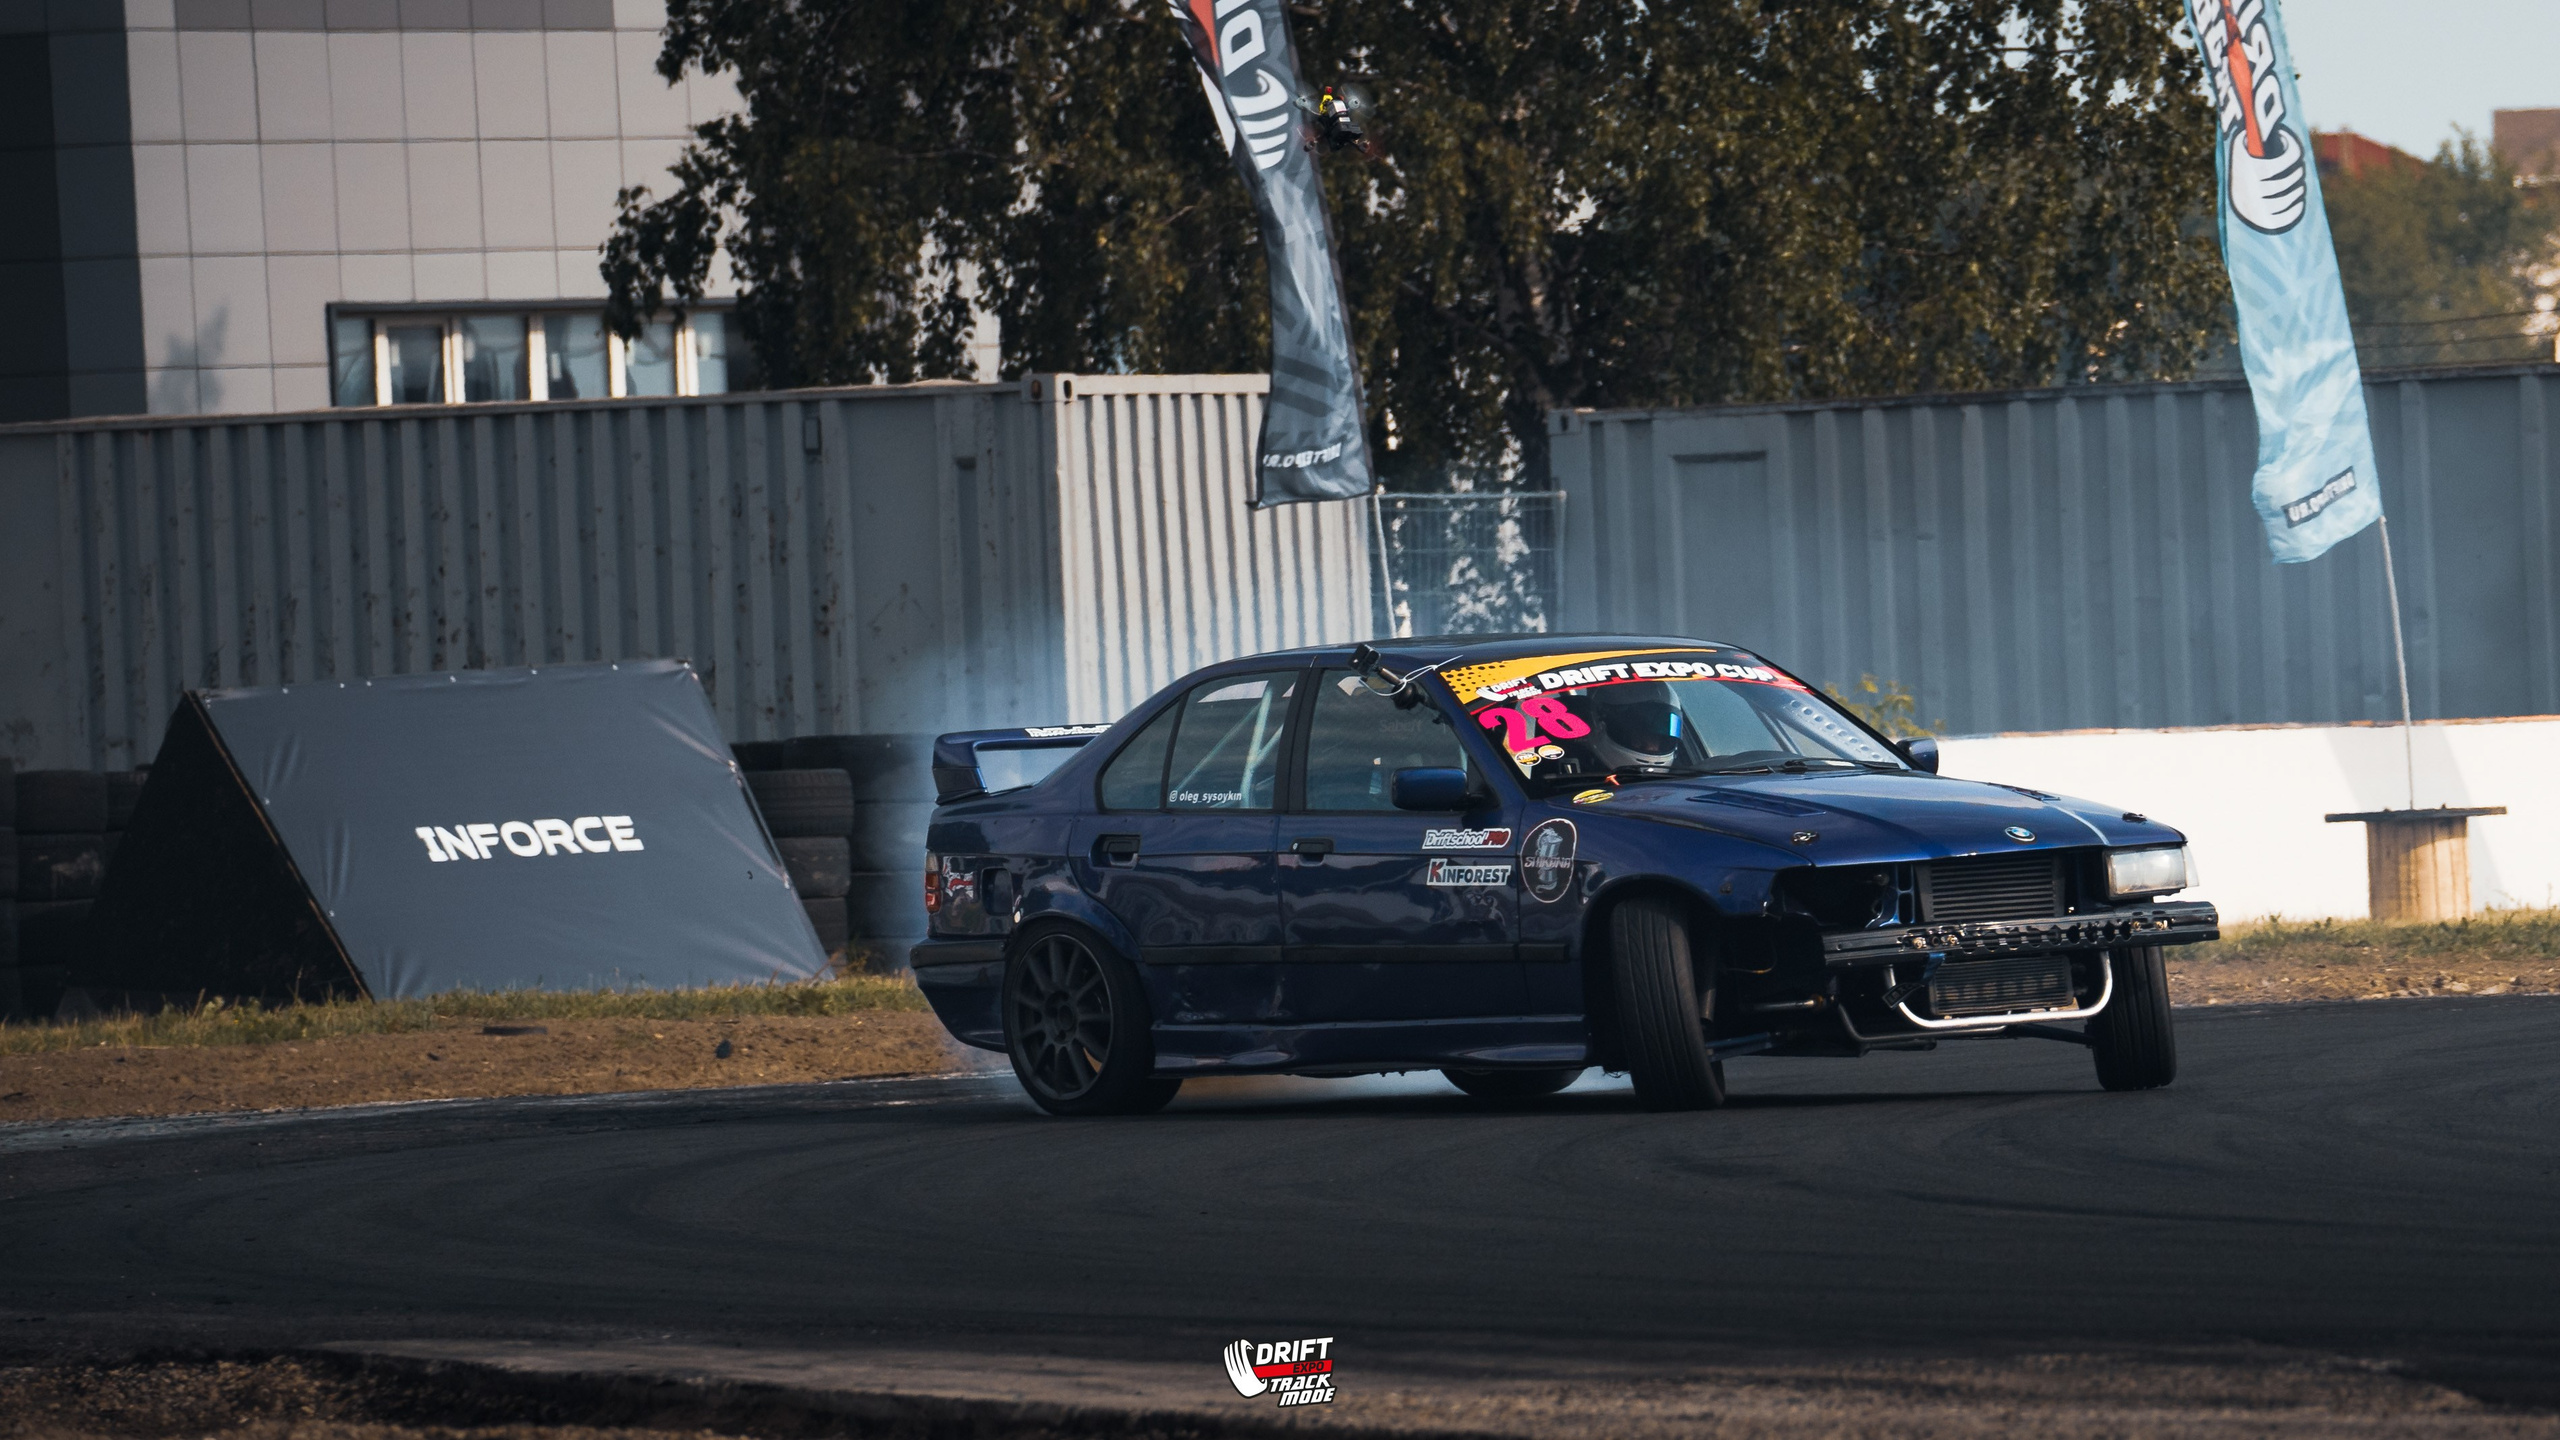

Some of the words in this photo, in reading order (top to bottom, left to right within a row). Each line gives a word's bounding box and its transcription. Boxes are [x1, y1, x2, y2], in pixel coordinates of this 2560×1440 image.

[1490, 677, 1528, 693] DRIFT
[1538, 663, 1630, 690] DRIFT
[1631, 662, 1715, 678] EXPO
[1714, 663, 1776, 682] CUP
[1478, 697, 1591, 752] 28
[415, 815, 644, 862] INFORCE
[1429, 861, 1509, 883] KINFOREST
